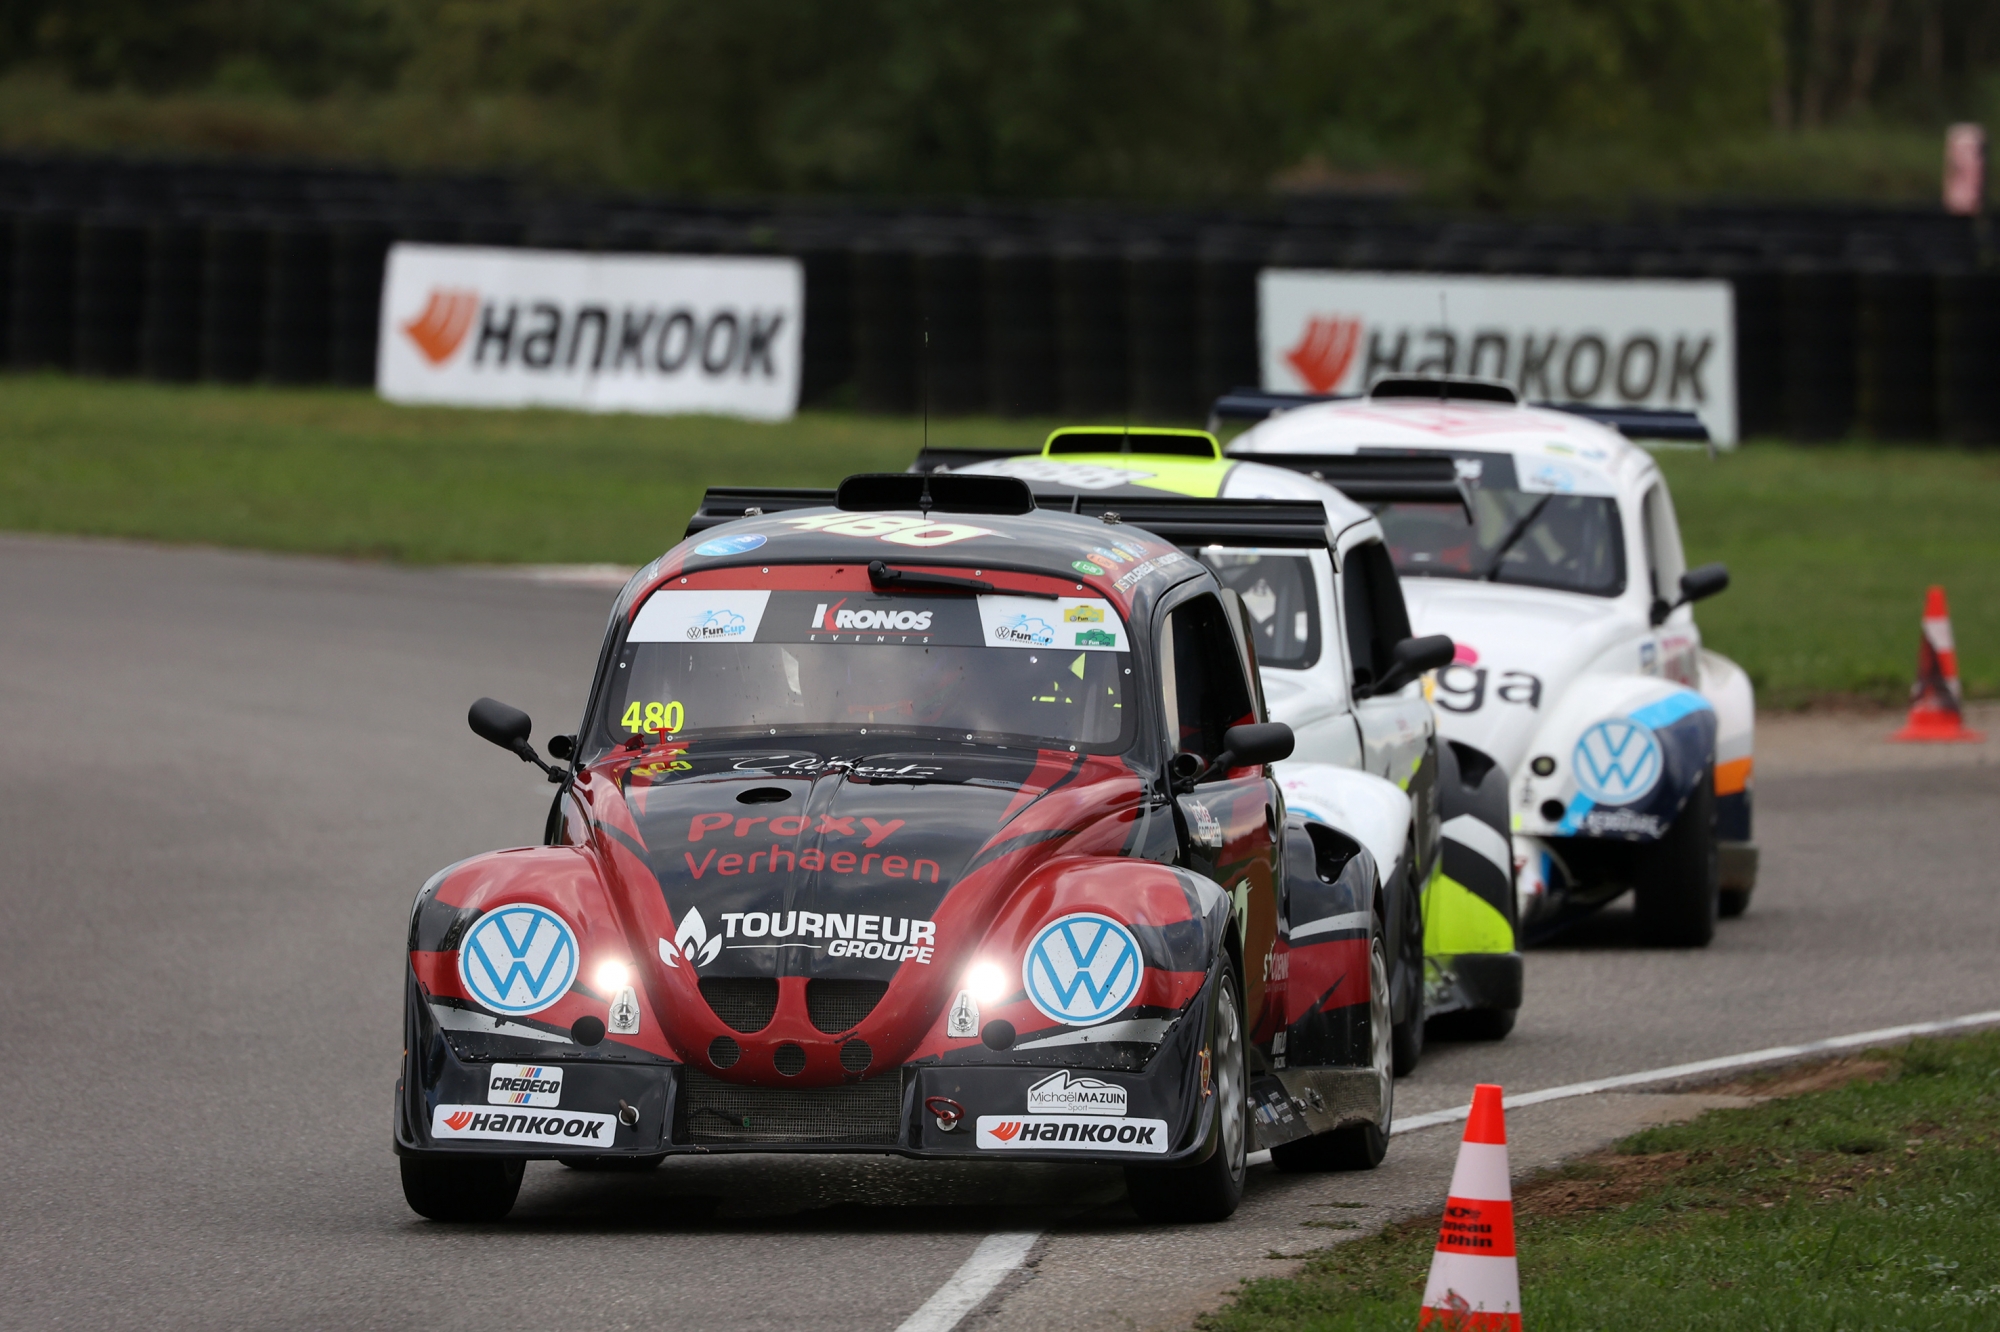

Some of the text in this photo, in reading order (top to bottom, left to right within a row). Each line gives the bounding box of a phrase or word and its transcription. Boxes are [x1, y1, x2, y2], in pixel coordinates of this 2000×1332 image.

[811, 597, 934, 631] KRONOS
[702, 625, 746, 635] FunCup
[810, 634, 929, 643] EVENTS
[621, 701, 685, 734] 480
[687, 812, 905, 848] Proxy
[684, 844, 940, 883] Verhaeren
[721, 911, 936, 946] TOURNEUR
[827, 940, 935, 964] GROUPE
[491, 1077, 560, 1093] CREDECO
[1068, 1103, 1088, 1112] Sport
